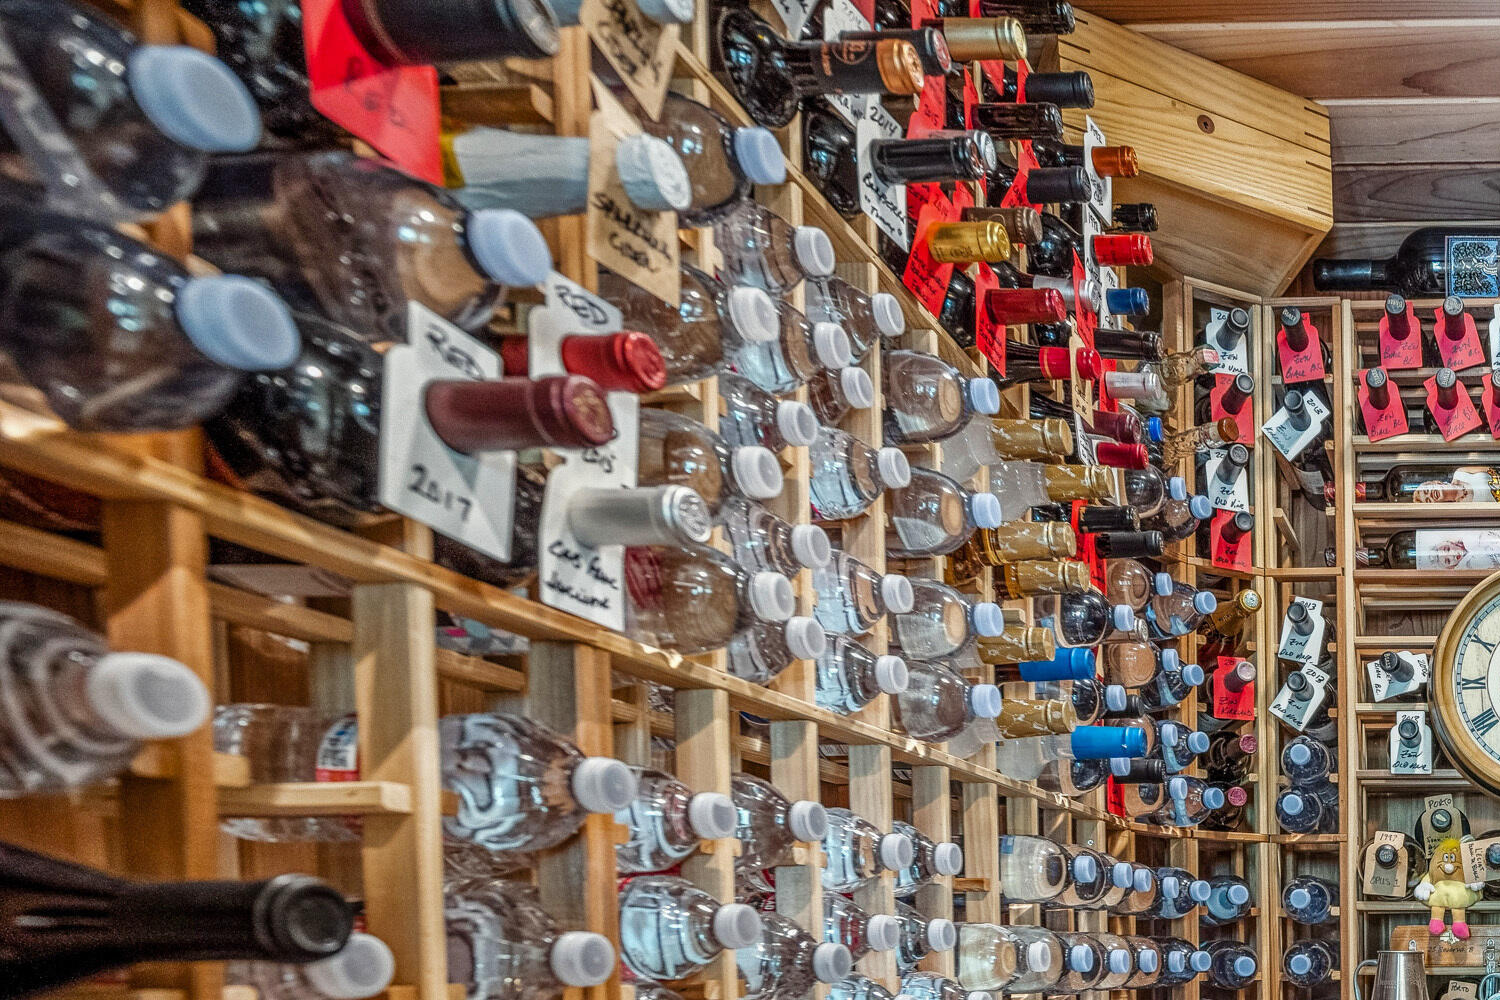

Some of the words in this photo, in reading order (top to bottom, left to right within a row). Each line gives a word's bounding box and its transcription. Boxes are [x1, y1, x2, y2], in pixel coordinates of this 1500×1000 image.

[1470, 633, 1495, 653] X
[1305, 668, 1325, 684] 2013
[1461, 676, 1486, 690] IX
[1471, 707, 1500, 736] VIII
[1428, 798, 1452, 809] PORTO
